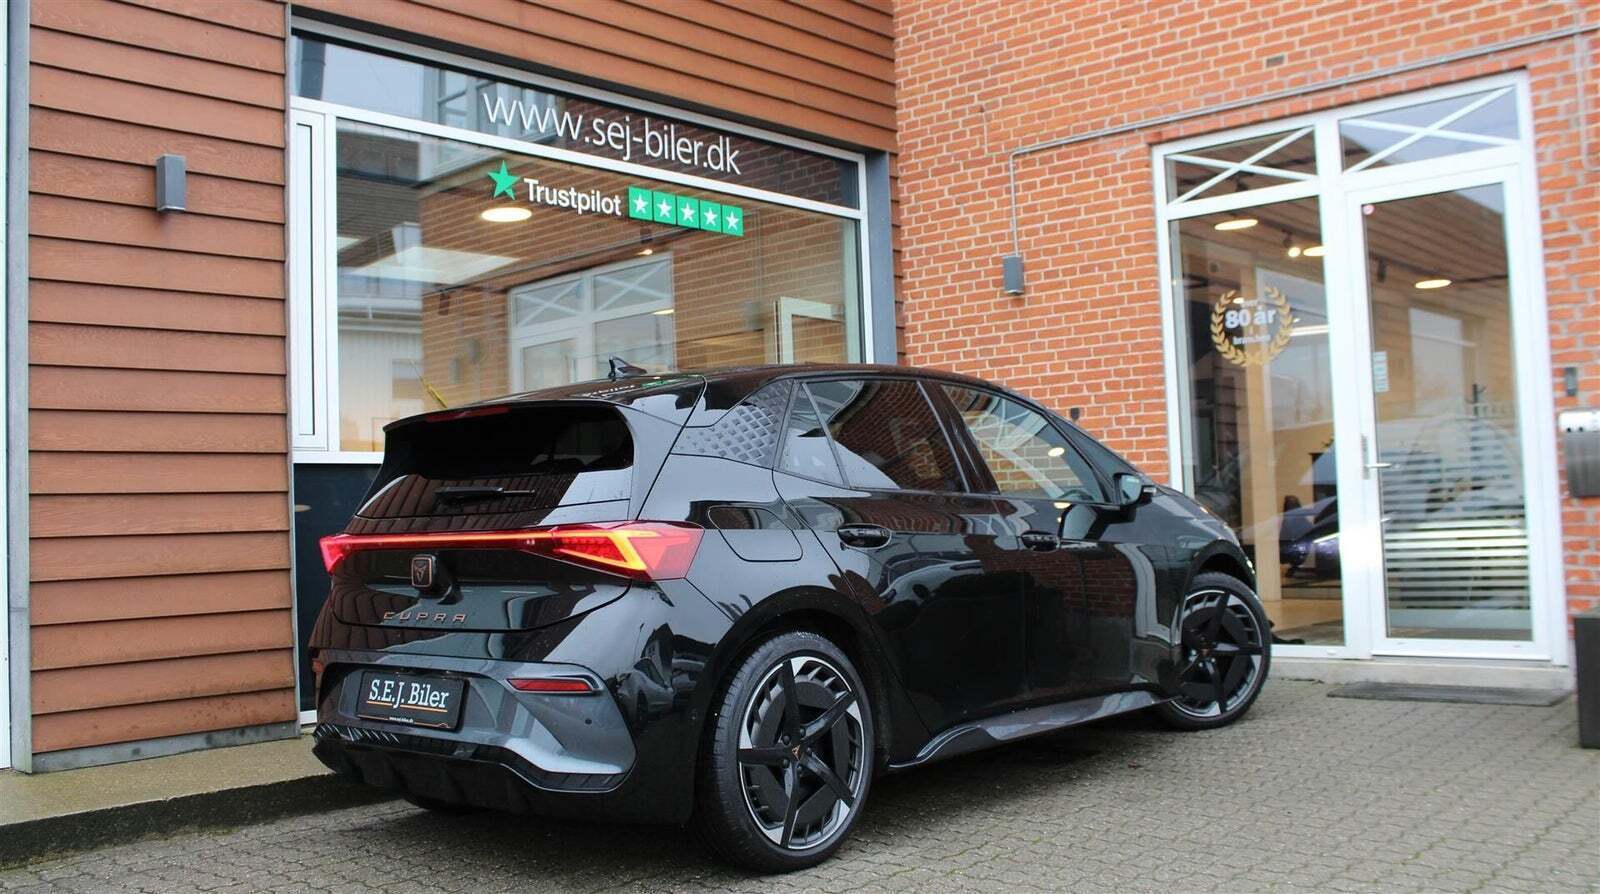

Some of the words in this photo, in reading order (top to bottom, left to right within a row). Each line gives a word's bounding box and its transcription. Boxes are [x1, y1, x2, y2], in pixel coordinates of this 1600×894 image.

[483, 93, 742, 175] www.sej-biler.dk
[523, 177, 622, 216] Trustpilot
[1225, 309, 1251, 329] 80
[1253, 304, 1277, 325] år
[383, 611, 467, 624] CUPRA
[369, 679, 405, 709] S.E.J.
[408, 682, 449, 709] Biler
